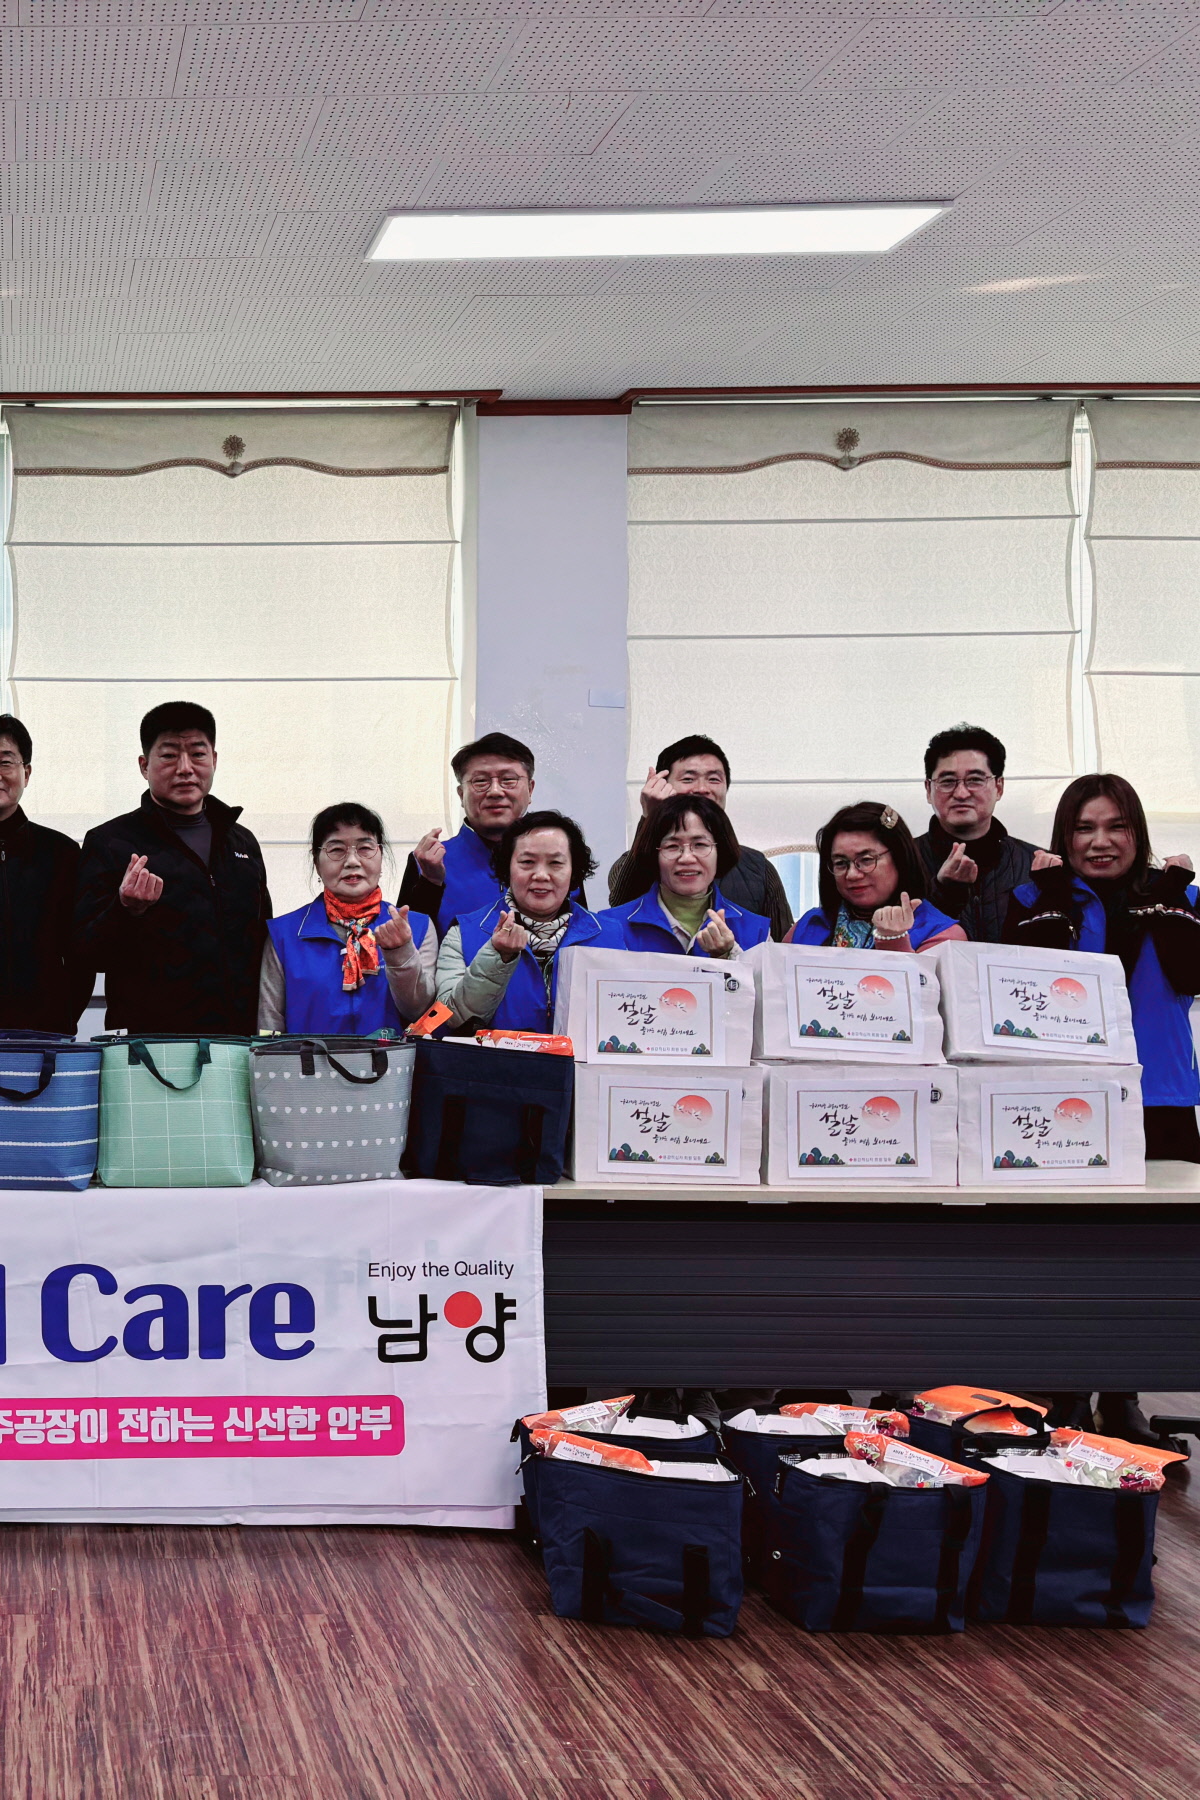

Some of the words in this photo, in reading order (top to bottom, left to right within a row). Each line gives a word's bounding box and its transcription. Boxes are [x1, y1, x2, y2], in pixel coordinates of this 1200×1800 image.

[816, 985, 857, 1011] 설날
[1009, 986, 1050, 1011] 설날
[617, 999, 658, 1026] 설날
[630, 1107, 671, 1134] 설날
[819, 1110, 860, 1137] 설날
[1012, 1112, 1053, 1140] 설날
[368, 1262, 416, 1281] Enjoy
[422, 1262, 449, 1277] the
[454, 1260, 514, 1279] Quality
[40, 1263, 315, 1363] Care
[368, 1291, 516, 1363] 남양
[118, 1407, 214, 1443] 전하는
[223, 1406, 320, 1442] 신선한
[327, 1405, 392, 1440] 안부
